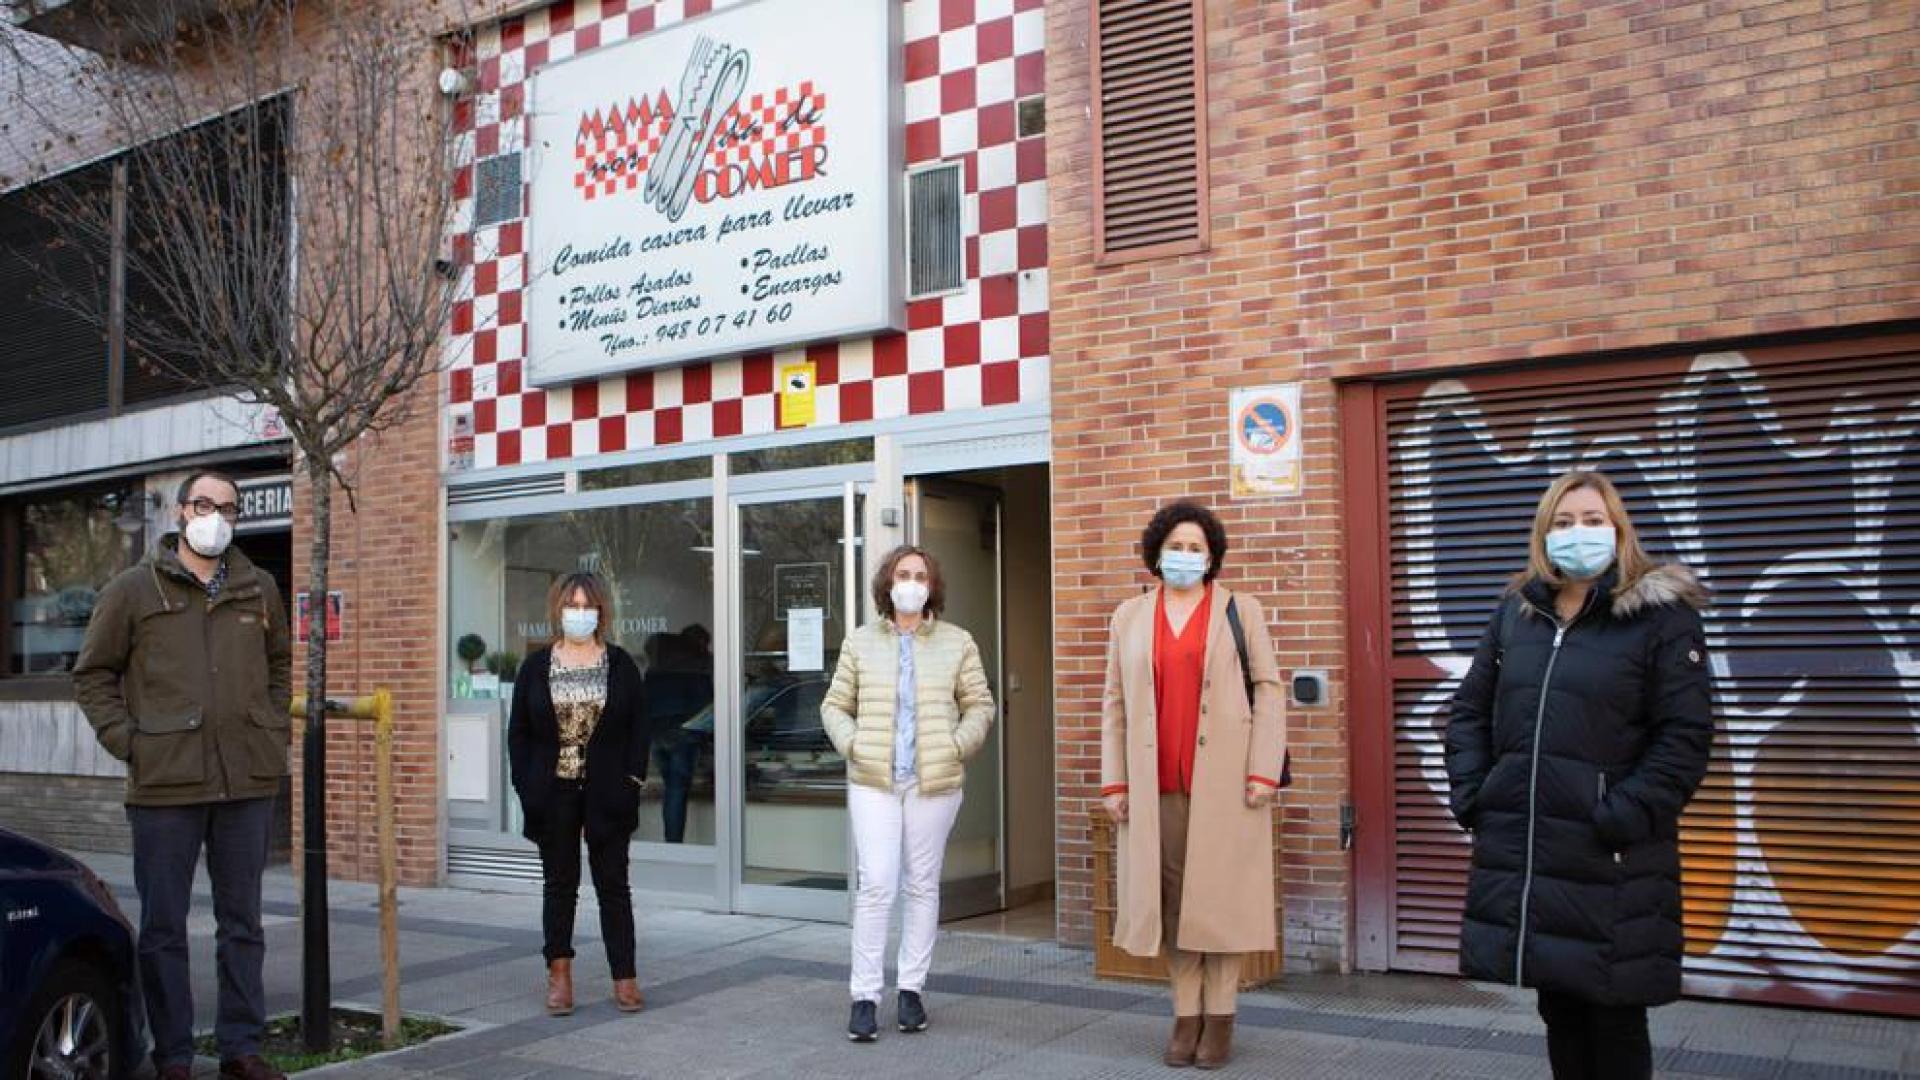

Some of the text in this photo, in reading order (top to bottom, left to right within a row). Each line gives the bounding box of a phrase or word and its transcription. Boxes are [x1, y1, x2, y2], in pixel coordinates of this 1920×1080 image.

[576, 86, 676, 145] MAMA
[782, 94, 823, 131] de
[694, 144, 828, 204] COMER
[553, 192, 855, 276] Comida casera para llevar
[752, 241, 829, 274] Paellas
[569, 268, 692, 309] Pollos Asados
[752, 270, 842, 302] Encargos
[570, 295, 701, 332] Menús Diarios
[656, 319, 692, 341] 948
[697, 315, 726, 336] 07
[733, 309, 757, 329] 41
[766, 302, 792, 325] 60
